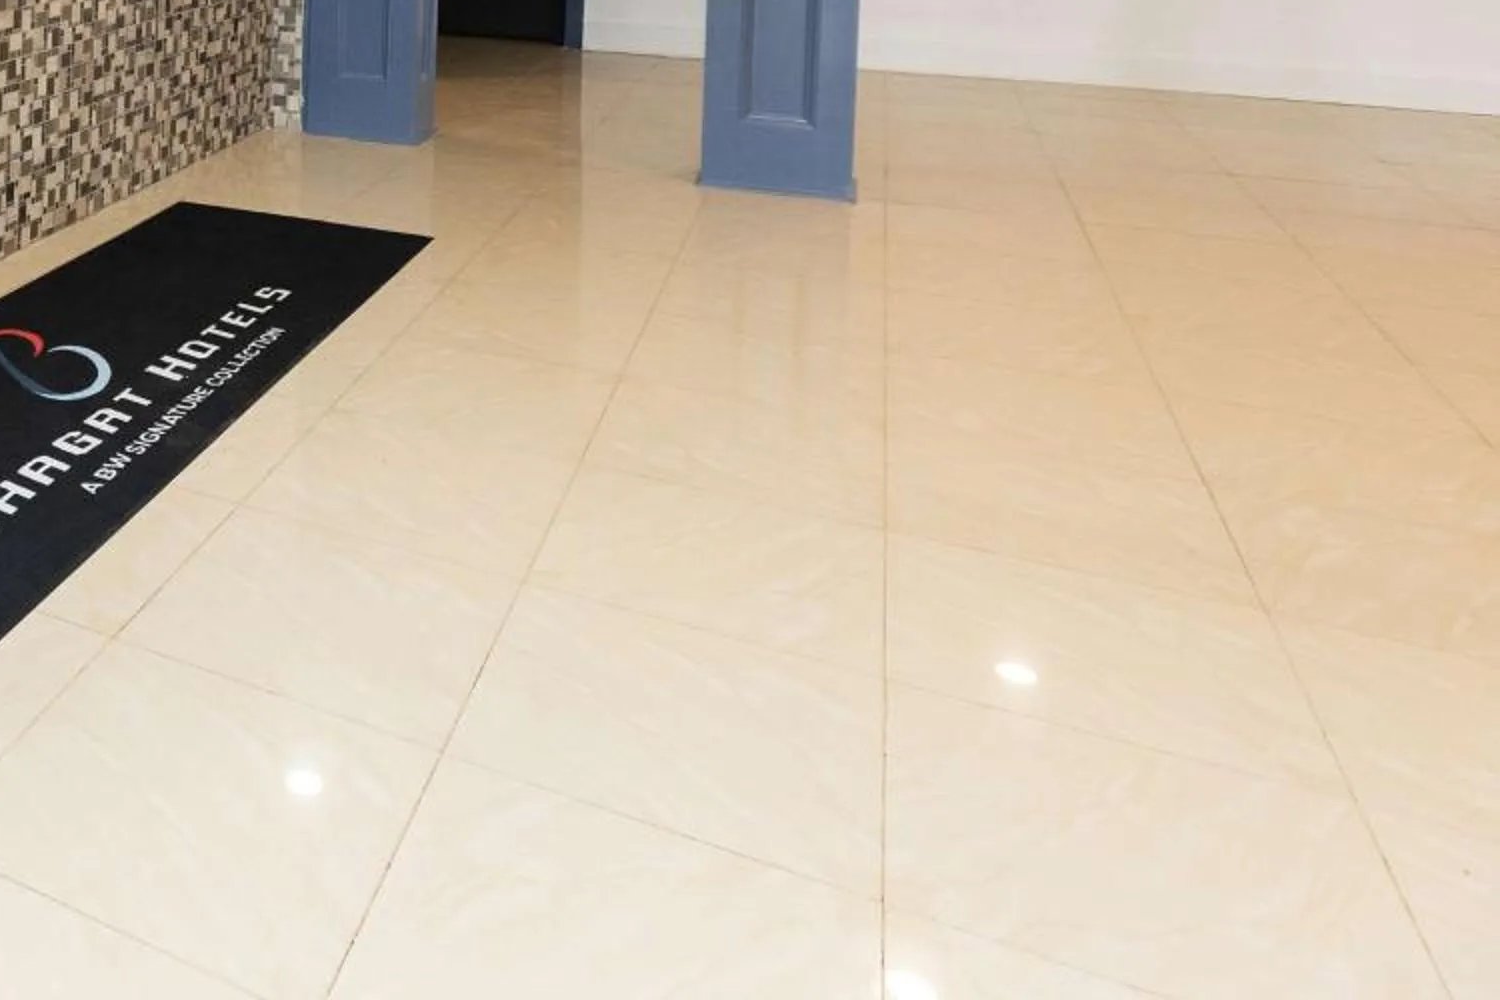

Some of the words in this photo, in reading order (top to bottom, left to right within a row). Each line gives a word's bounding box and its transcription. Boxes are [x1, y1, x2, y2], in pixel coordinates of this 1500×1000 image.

[143, 286, 293, 381] HOTELS
[79, 480, 103, 495] A
[94, 453, 132, 482] BW
[124, 378, 215, 456] SIGNATURE
[204, 326, 288, 388] COLLECTION
